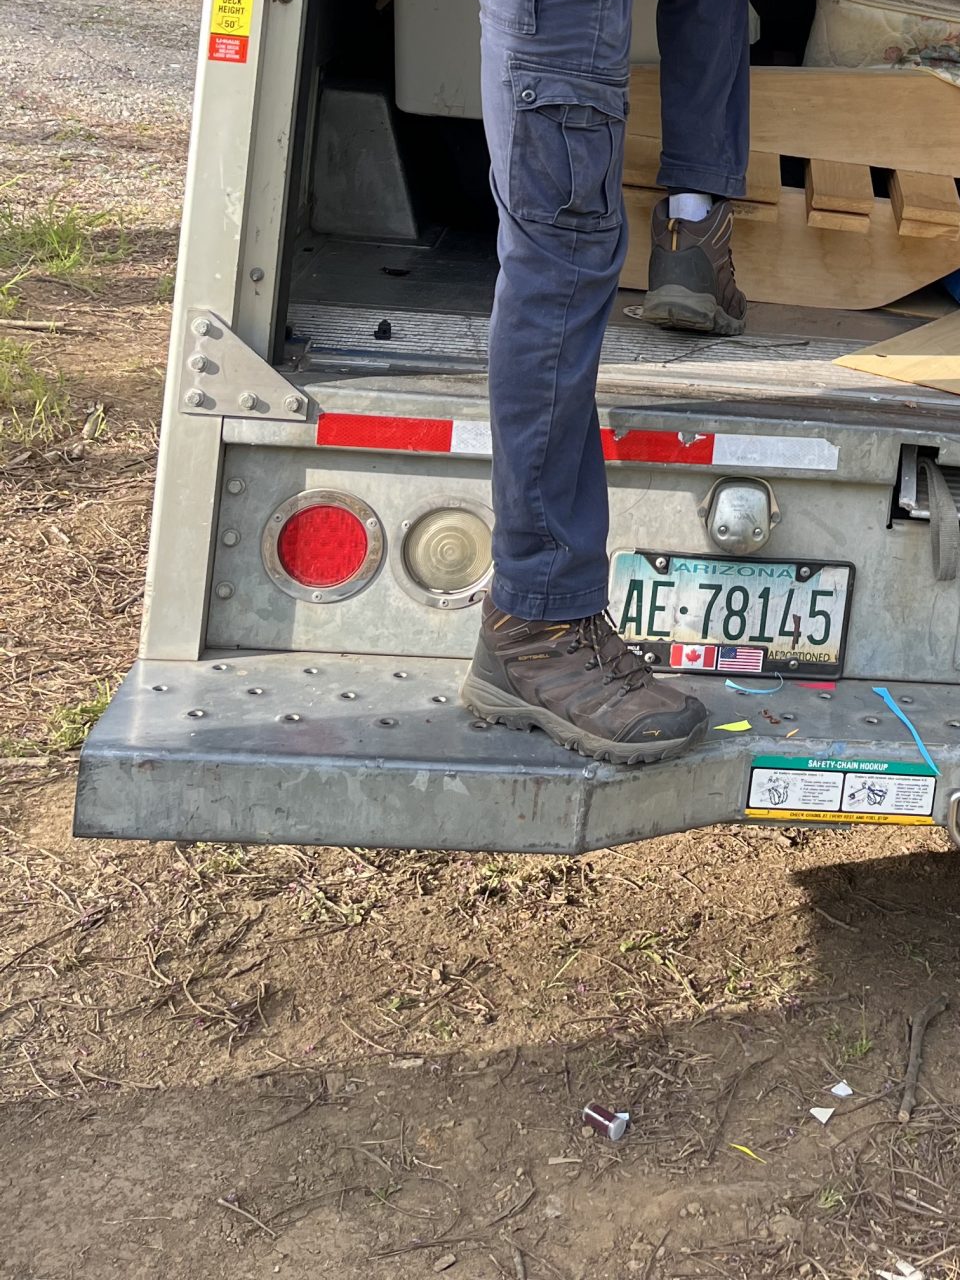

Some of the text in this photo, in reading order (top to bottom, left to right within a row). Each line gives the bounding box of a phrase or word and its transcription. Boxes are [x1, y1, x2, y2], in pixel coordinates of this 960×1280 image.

[218, 6, 245, 15] HEIGHT
[674, 562, 793, 579] ARIZONA
[807, 760, 889, 771] SAFETY-CHAIN HOOKUP
